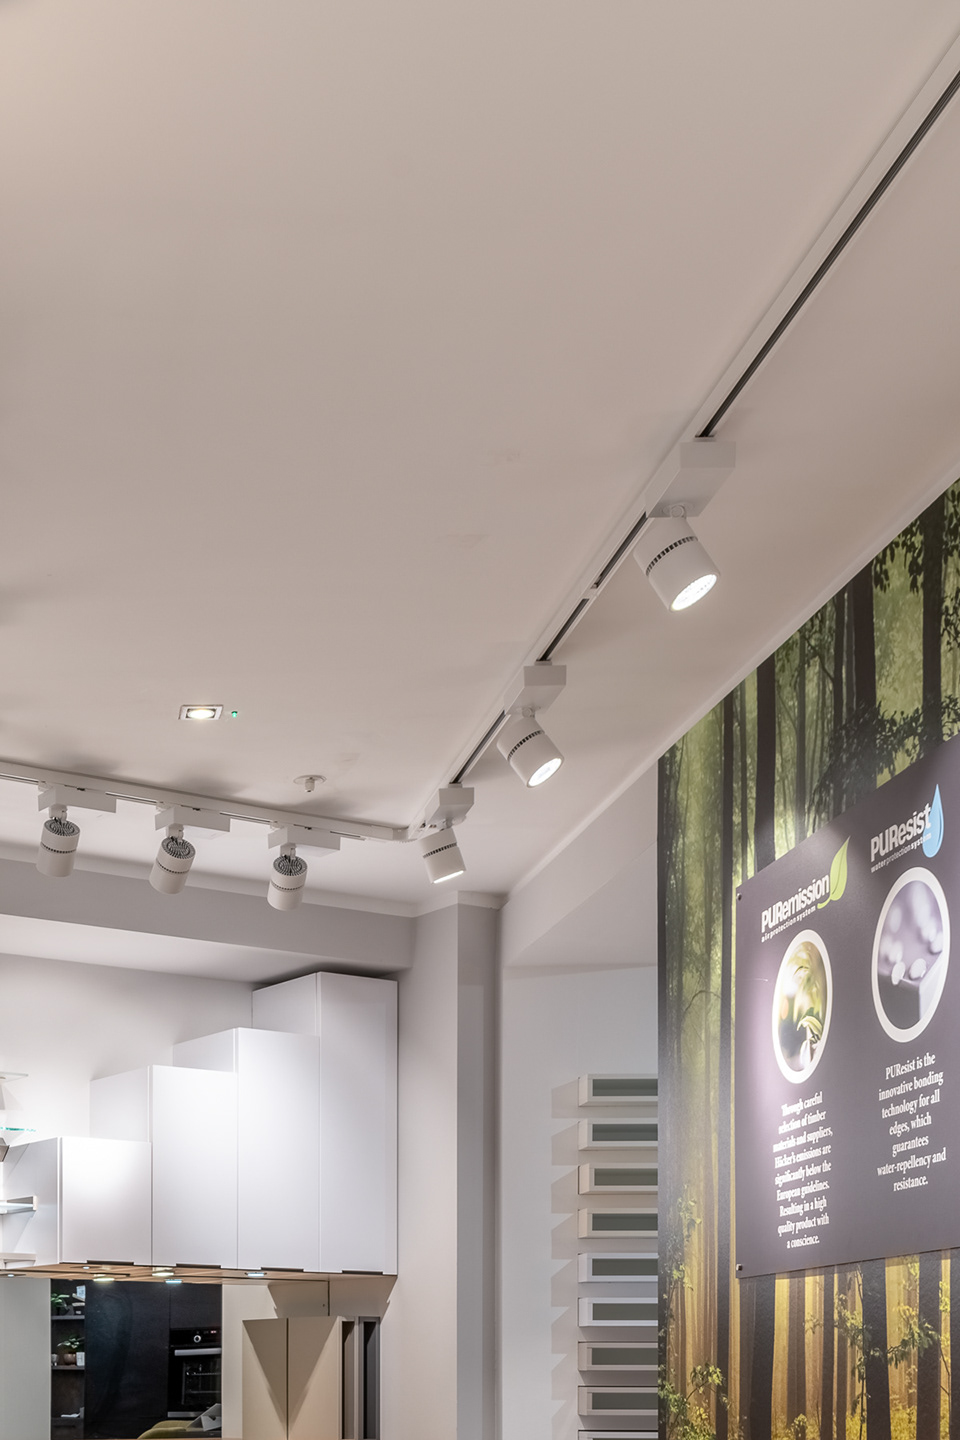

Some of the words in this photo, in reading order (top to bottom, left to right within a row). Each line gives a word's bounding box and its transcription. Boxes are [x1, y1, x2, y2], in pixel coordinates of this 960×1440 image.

[870, 803, 932, 863] PUResist
[761, 874, 830, 933] PURemission
[885, 1060, 915, 1080] PUResist
[916, 1056, 923, 1070] is
[923, 1052, 936, 1067] the
[878, 1080, 913, 1101] innovative
[913, 1071, 944, 1090] bonding
[803, 1090, 823, 1109] careful
[881, 1098, 918, 1119] technology
[918, 1093, 930, 1108] for
[930, 1088, 941, 1104] all
[801, 1112, 808, 1127] of
[889, 1121, 910, 1137] edges,
[910, 1111, 932, 1129] which
[822, 1144, 831, 1155] are
[892, 1135, 929, 1157] guarantees
[805, 1163, 822, 1177] below
[822, 1159, 832, 1173] the
[876, 1154, 932, 1176] water-repellency
[932, 1146, 947, 1163] and
[776, 1187, 801, 1202] European
[893, 1175, 929, 1192] resistance.
[803, 1200, 810, 1212] in
[810, 1201, 814, 1211] a
[814, 1195, 827, 1212] high
[777, 1220, 796, 1237] quality
[795, 1215, 817, 1234] product
[816, 1212, 830, 1226] with
[786, 1240, 791, 1249] a
[790, 1234, 820, 1248] conscience.
